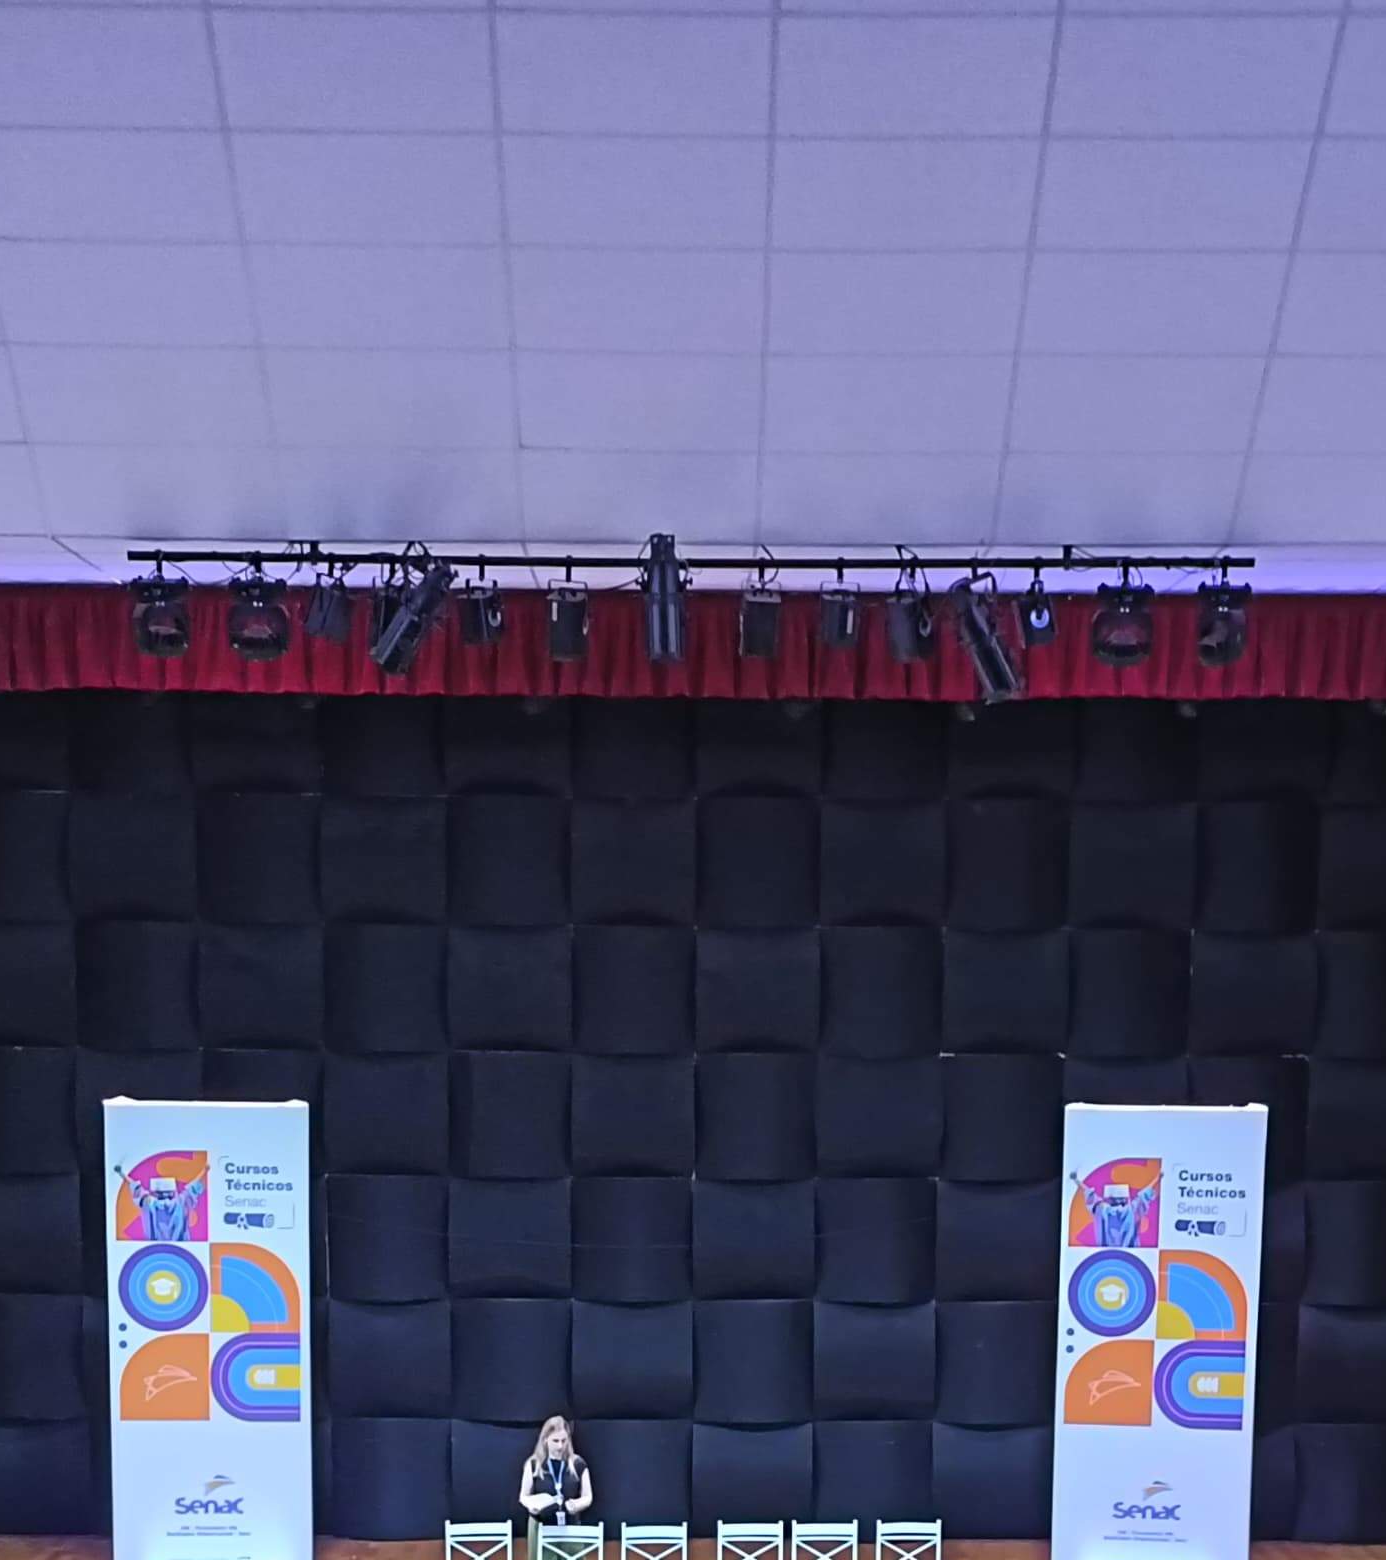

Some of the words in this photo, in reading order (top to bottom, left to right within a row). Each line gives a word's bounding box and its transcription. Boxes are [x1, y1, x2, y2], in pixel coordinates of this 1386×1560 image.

[225, 1162, 279, 1175] Cursos
[1178, 1169, 1233, 1182] Cursos
[225, 1178, 294, 1191] Técnicos
[1178, 1186, 1246, 1199] Técnicos
[174, 1497, 244, 1515] Senac
[1112, 1501, 1182, 1521] Senac
